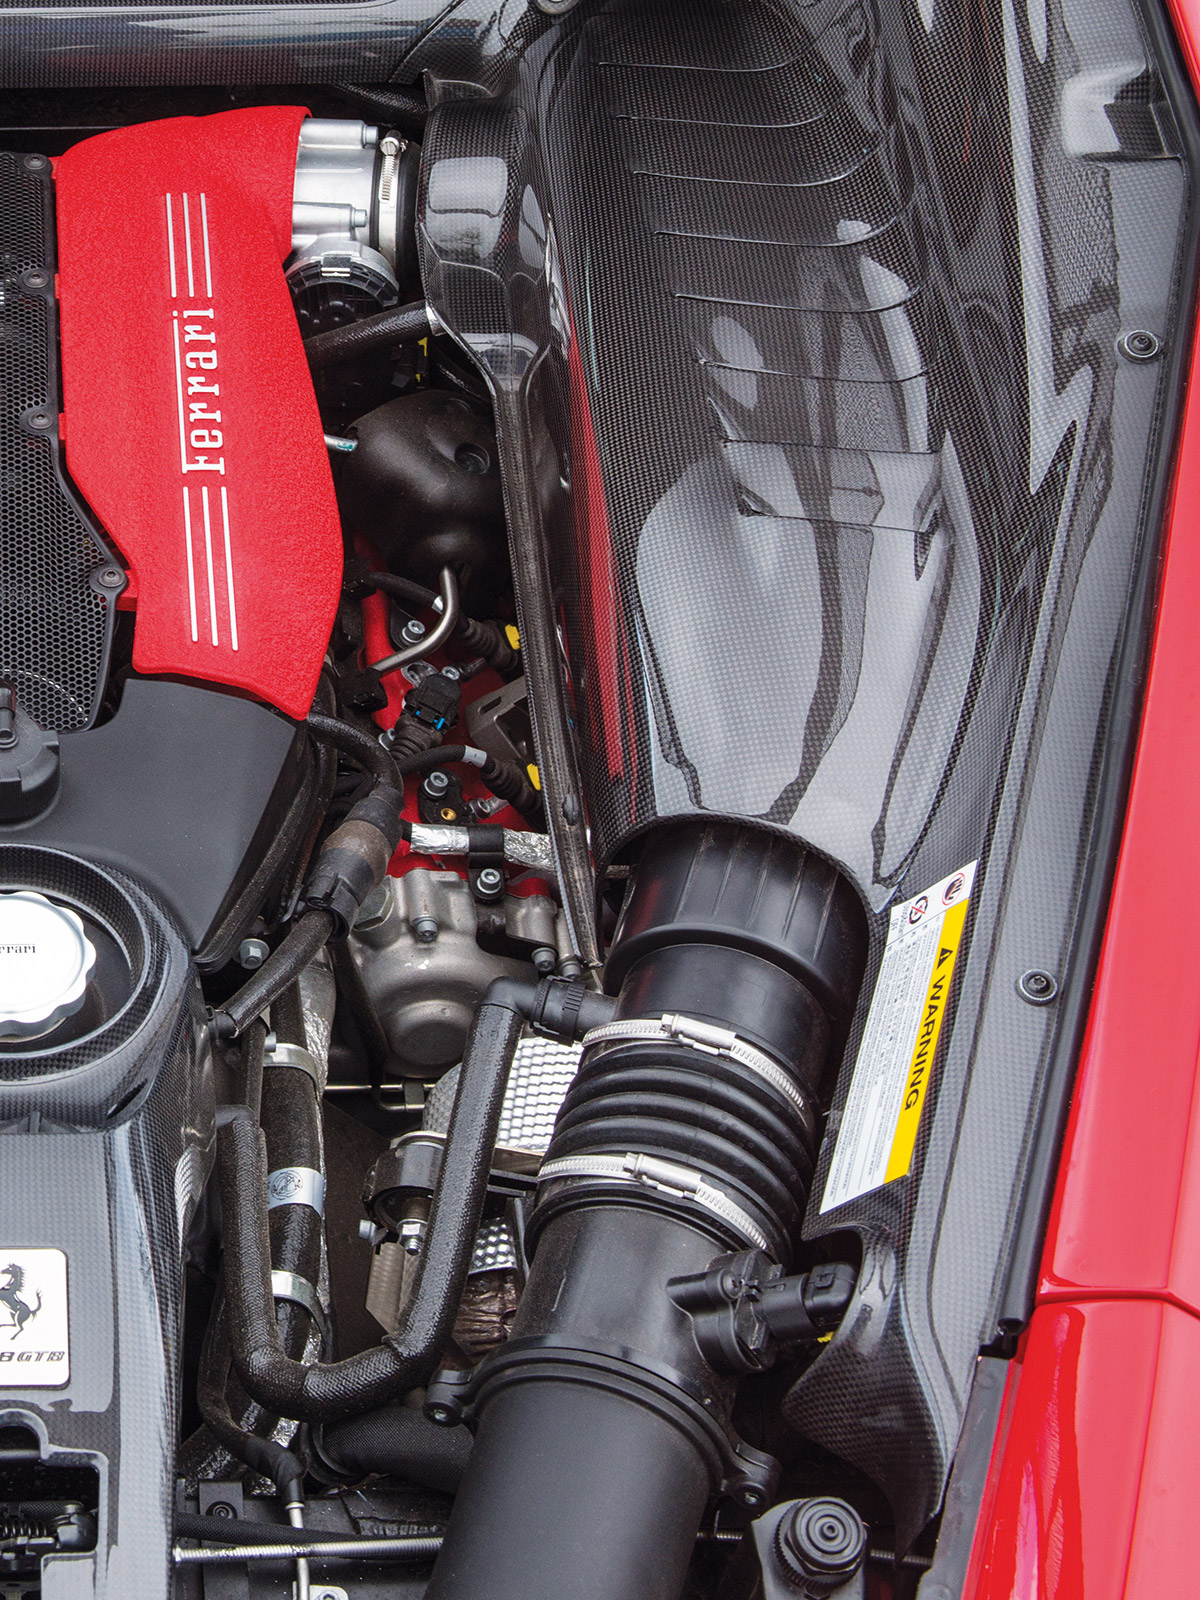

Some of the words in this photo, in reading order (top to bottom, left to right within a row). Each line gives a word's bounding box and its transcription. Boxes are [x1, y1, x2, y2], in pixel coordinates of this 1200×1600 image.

[172, 308, 225, 475] Ferrari
[905, 975, 946, 1111] WARNING
[17, 1351, 65, 1362] GTB
